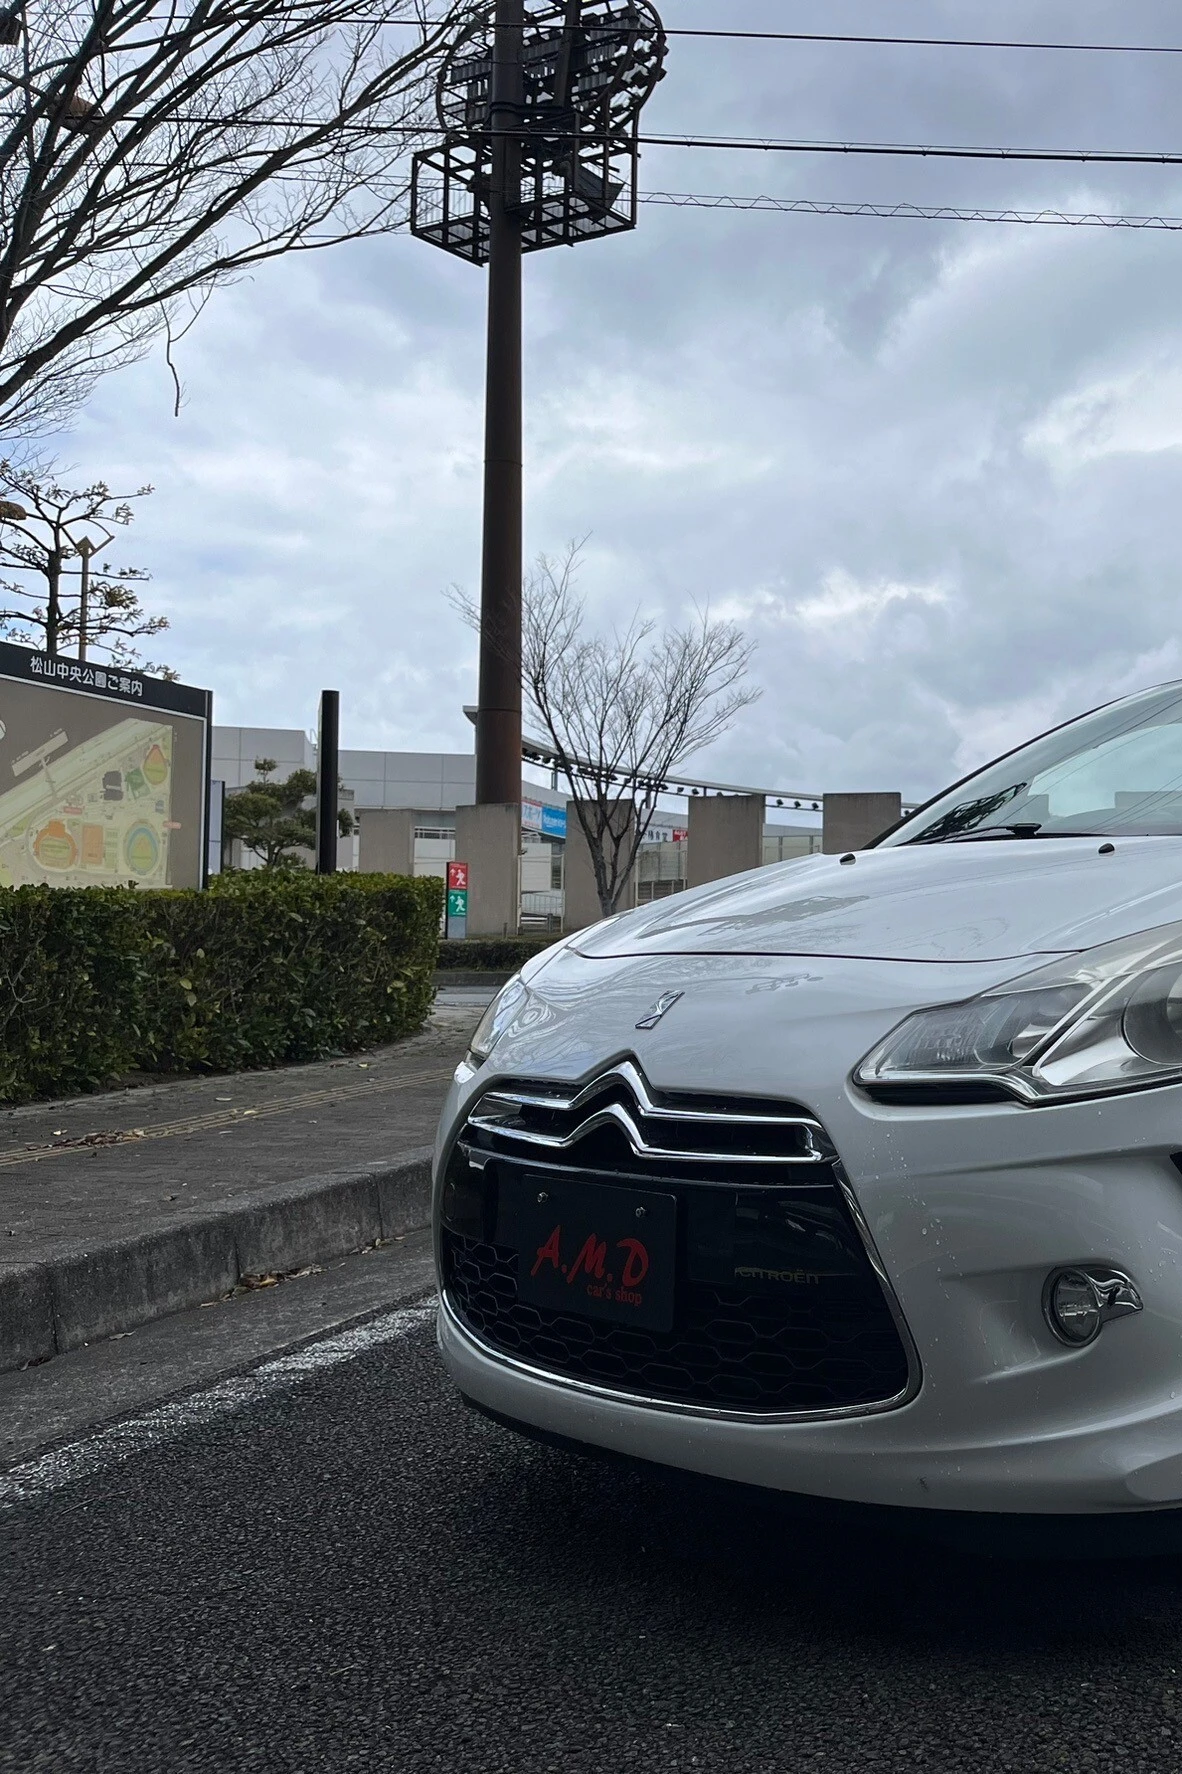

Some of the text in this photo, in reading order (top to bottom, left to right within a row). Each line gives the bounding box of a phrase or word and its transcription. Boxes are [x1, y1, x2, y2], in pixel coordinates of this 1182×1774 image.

[30, 655, 143, 697] 松山中央公園ご案内
[614, 1286, 643, 1307] shop
